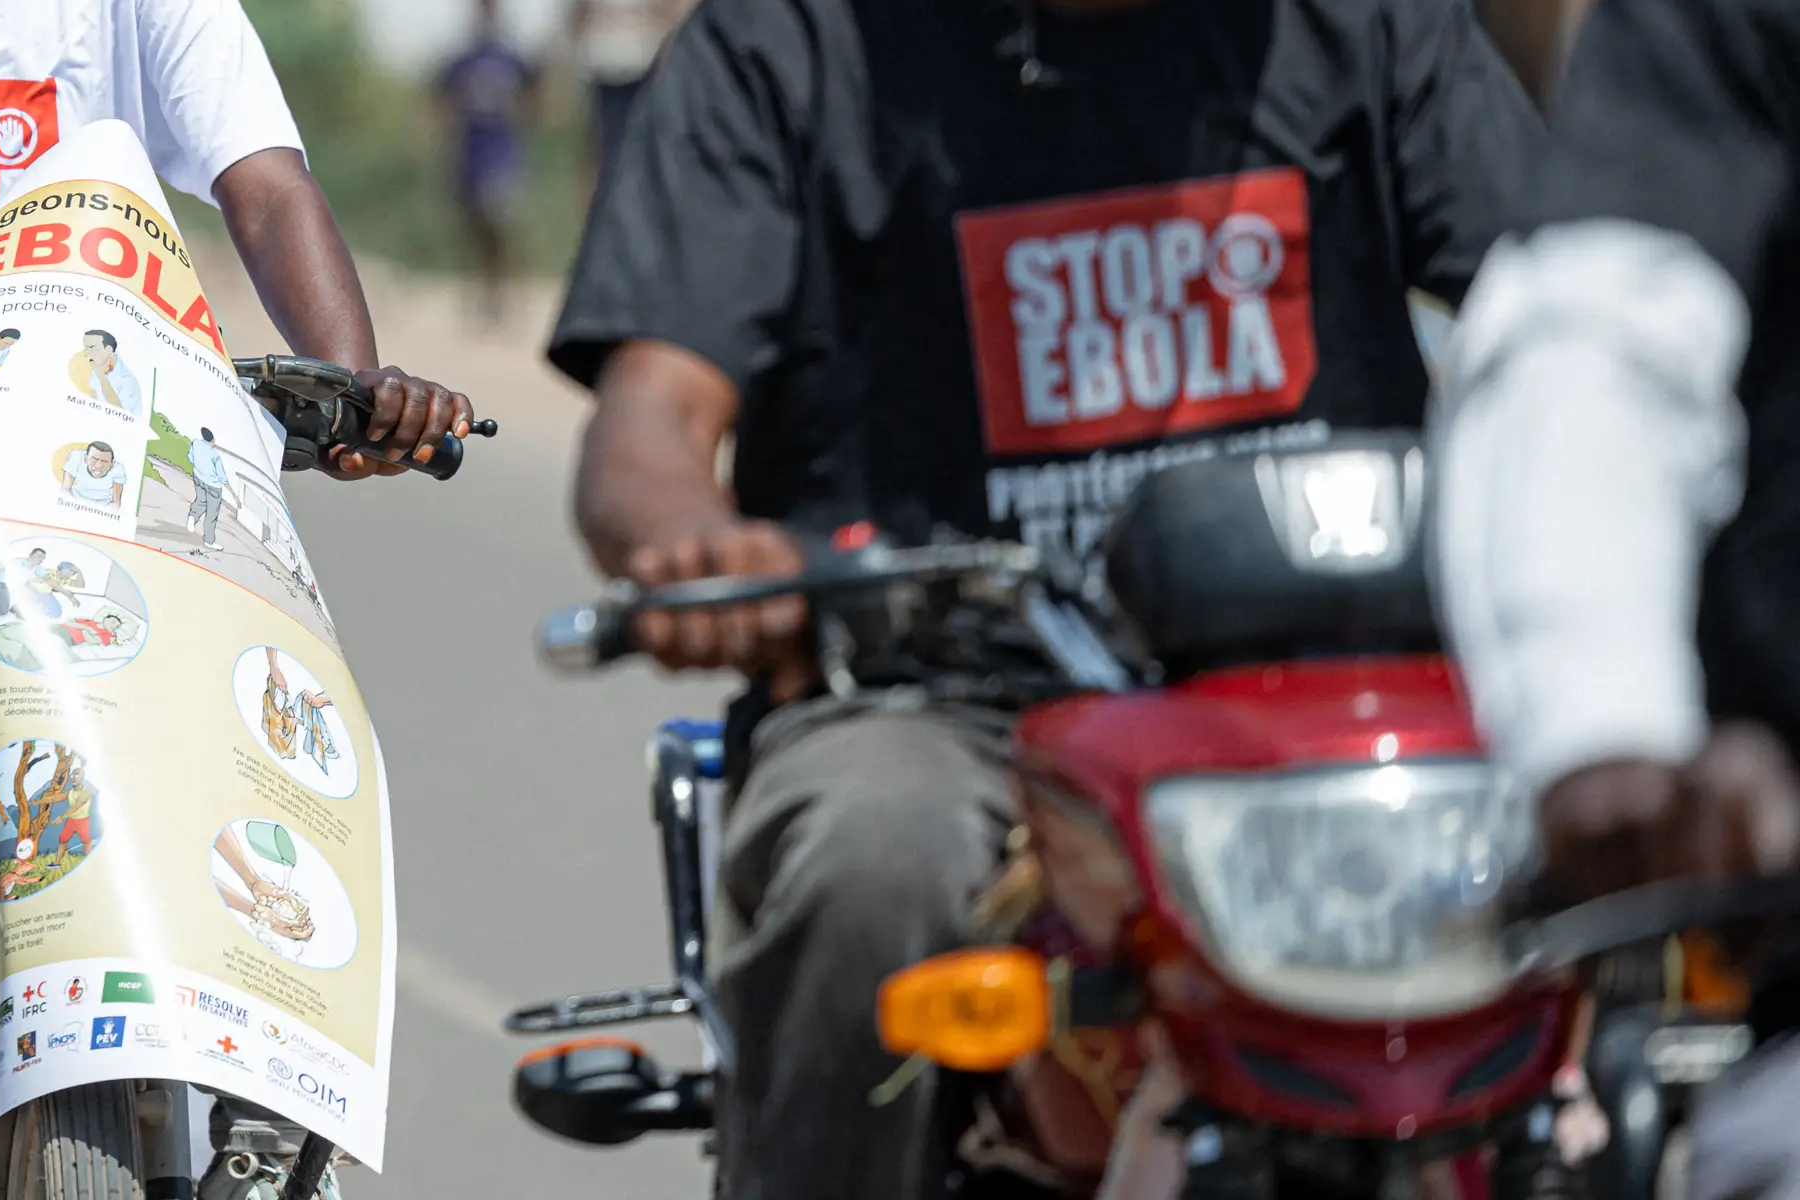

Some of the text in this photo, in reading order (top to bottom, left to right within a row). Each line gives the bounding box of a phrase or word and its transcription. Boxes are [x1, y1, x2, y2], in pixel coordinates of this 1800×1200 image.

[1005, 217, 1205, 338] STOP
[2, 299, 73, 321] proche.
[97, 292, 150, 330] rendez
[154, 327, 189, 357] vous
[1017, 293, 1287, 428] EBOLA
[66, 395, 136, 423] Mal de gorge
[56, 497, 122, 522] Saignement
[45, 909, 74, 920] animal
[22, 1002, 47, 1019] IFRC
[198, 1003, 249, 1028] TO SAVE LIVES
[199, 991, 250, 1021] RESOLVE
[95, 1033, 119, 1044] PEV
[298, 1073, 348, 1114] OIM
